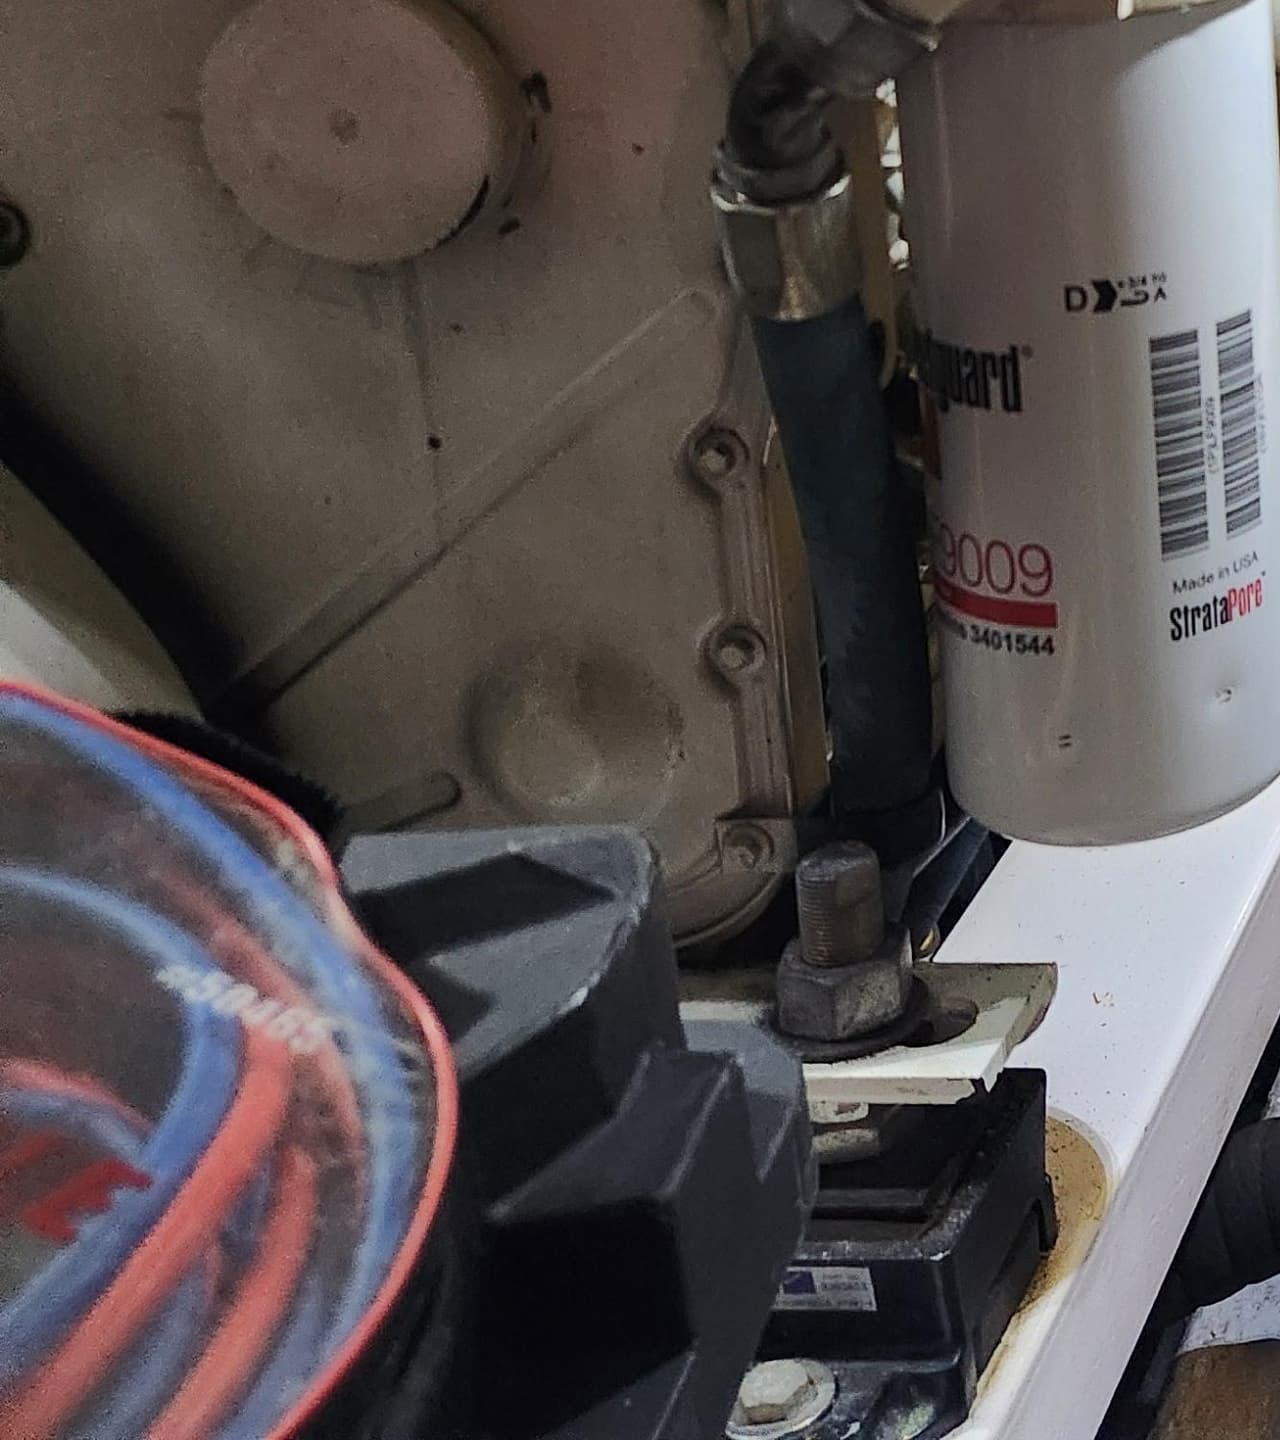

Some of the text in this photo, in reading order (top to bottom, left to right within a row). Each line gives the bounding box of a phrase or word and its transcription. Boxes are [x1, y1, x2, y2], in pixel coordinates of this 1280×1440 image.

[1172, 550, 1259, 595] Made in USA
[1169, 578, 1263, 641] StrataPore
[970, 624, 1055, 656] 3401544
